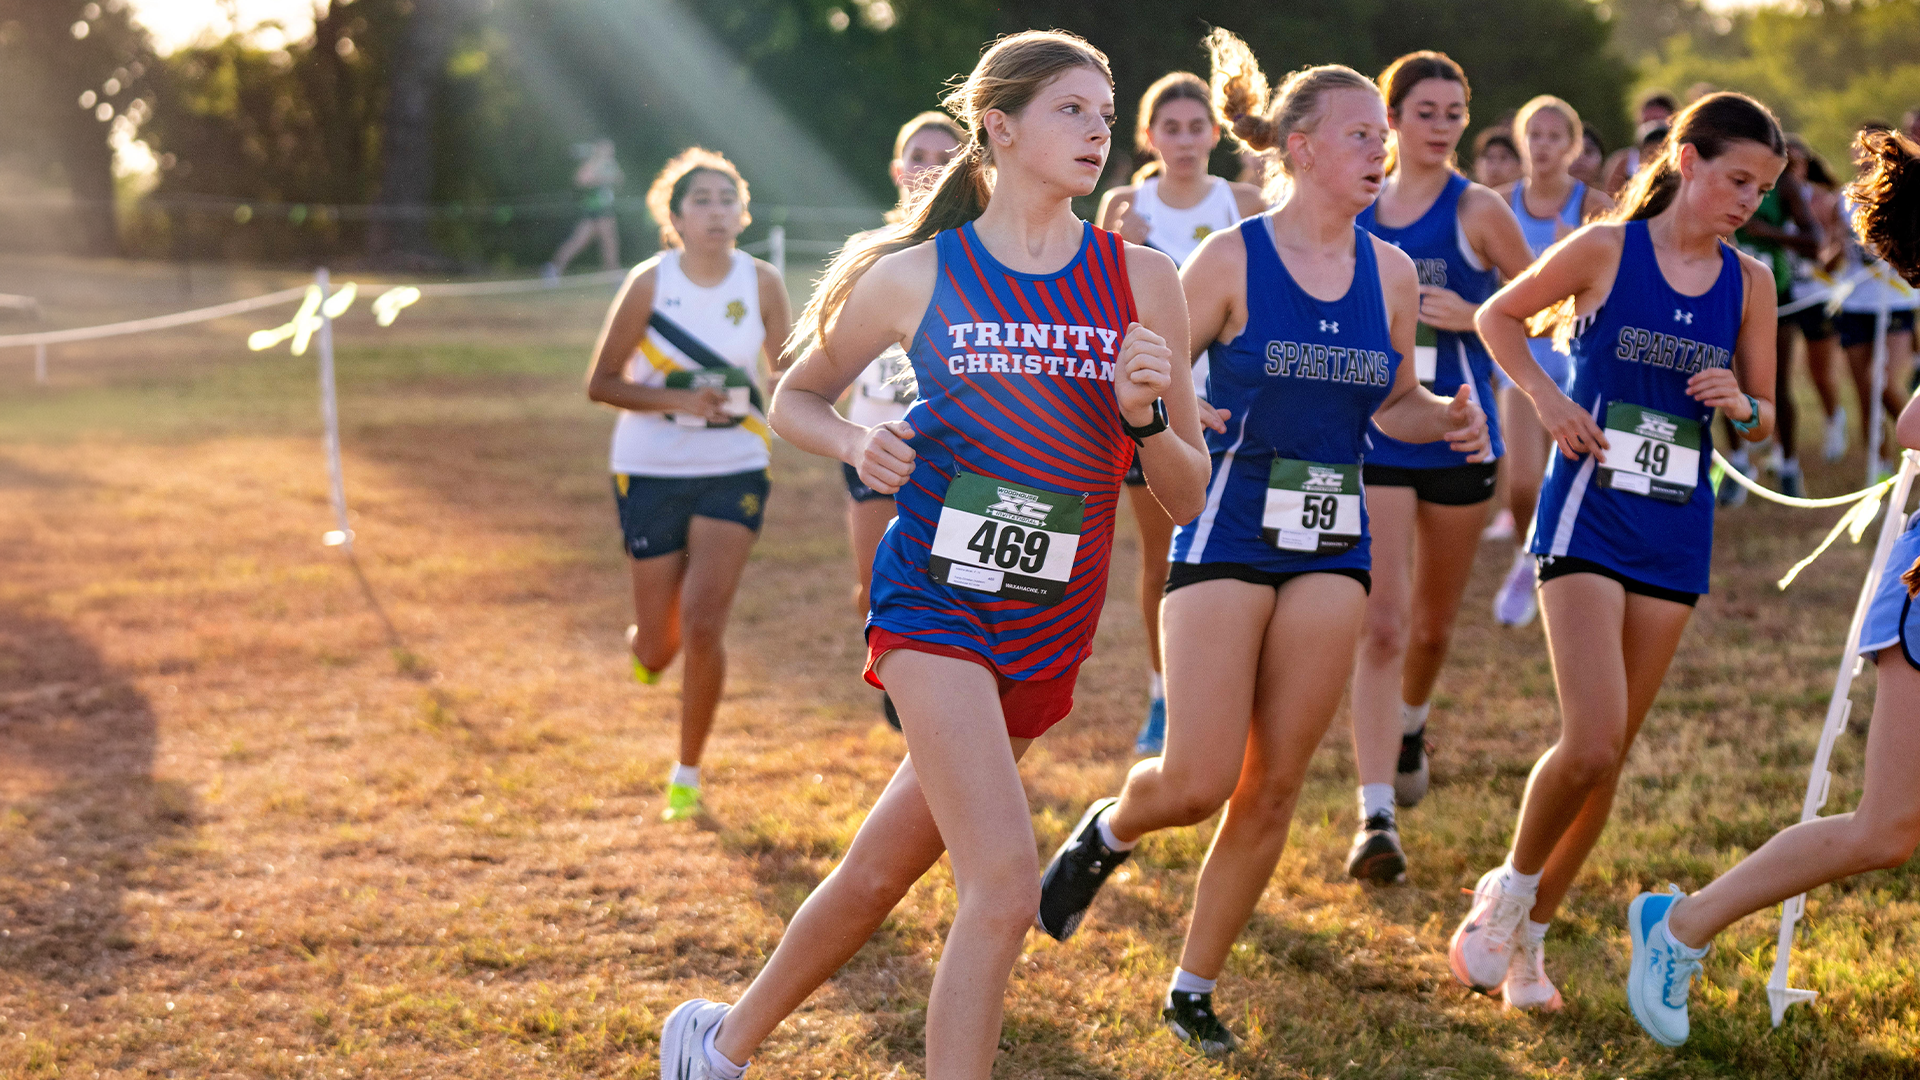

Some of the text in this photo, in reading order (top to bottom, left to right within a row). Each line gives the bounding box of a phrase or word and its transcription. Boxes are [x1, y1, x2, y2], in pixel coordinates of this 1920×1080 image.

[948, 322, 1117, 355] TRINITY
[1617, 325, 1730, 374] SPARTANS
[948, 353, 1115, 382] CHRISTIAN
[1265, 340, 1390, 386] SPARTANS
[1634, 439, 1670, 477] 49
[988, 494, 1053, 520] XC
[998, 488, 1038, 501] WOODHOUSE
[995, 510, 1037, 524] INVITATIONAL
[1301, 494, 1339, 530] 59
[967, 519, 1050, 573] 469
